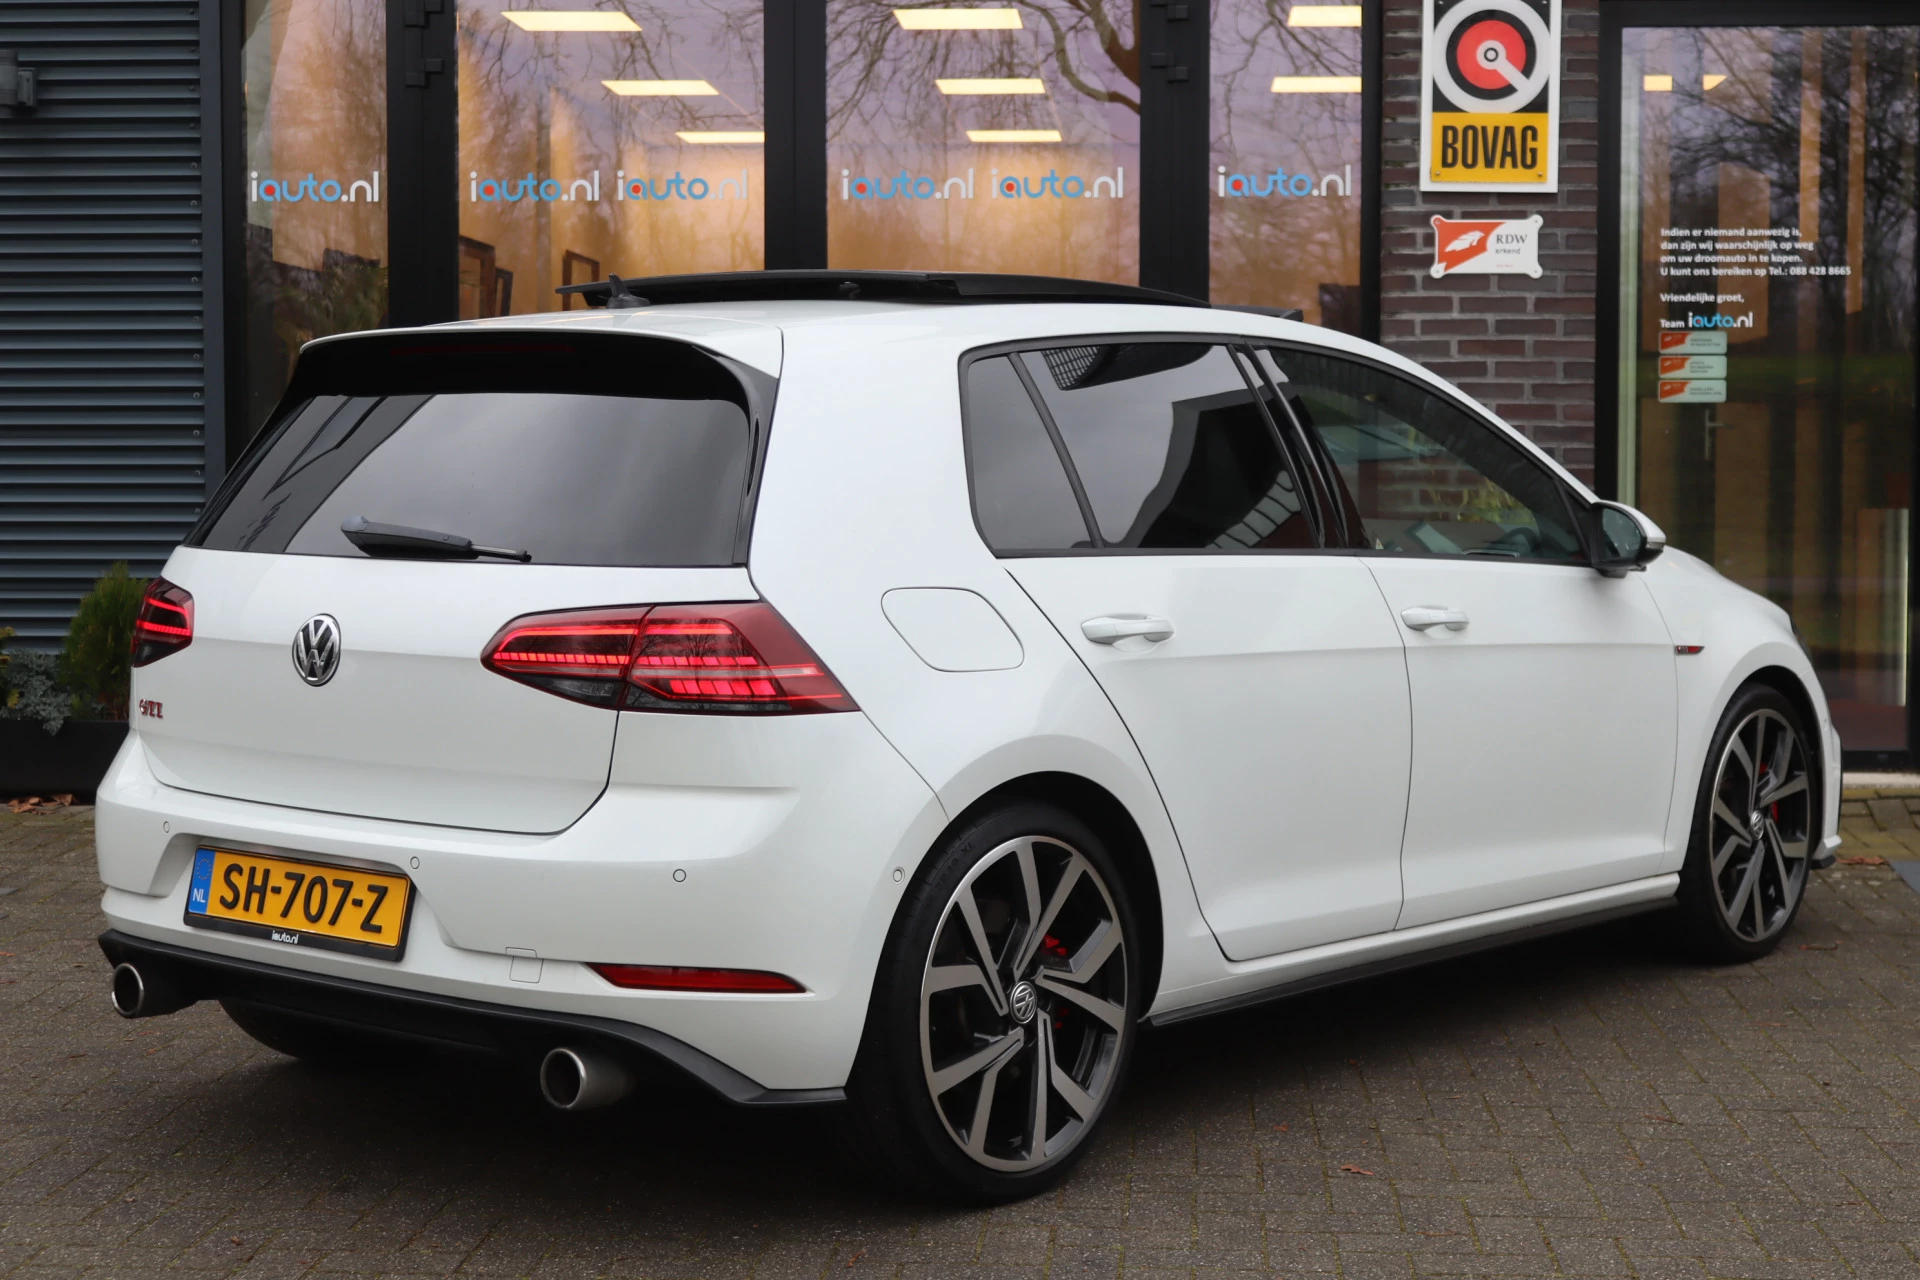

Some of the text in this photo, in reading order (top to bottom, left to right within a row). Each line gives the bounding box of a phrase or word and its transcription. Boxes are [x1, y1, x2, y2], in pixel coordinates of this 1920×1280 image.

[1441, 125, 1538, 170] BOVAG
[250, 170, 379, 202] iauto.nl
[470, 170, 600, 202] iauto.nl
[617, 168, 747, 201] iauto.nl
[841, 168, 974, 200] iauto.nl
[991, 166, 1123, 200] iauto.nl
[1217, 164, 1352, 198] iauto.nl
[1496, 234, 1528, 244] RDW
[1660, 228, 1690, 236] Indien
[1704, 227, 1745, 236] niemand
[1747, 228, 1790, 238] aanwezig
[1792, 227, 1802, 238] is,
[1495, 247, 1521, 255] erkend
[1661, 240, 1814, 251] dan zijn wij waarschijnlijk op weg
[1694, 254, 1746, 262] droomauto
[1748, 254, 1757, 262] in
[1759, 254, 1769, 262] te
[1771, 253, 1802, 264] kopen.
[1660, 267, 1668, 275] U
[1670, 267, 1691, 275] kunt
[1711, 266, 1752, 275] bereiken
[1754, 268, 1767, 277] op
[1769, 266, 1787, 275] Tel.:
[1789, 266, 1807, 275] 088
[1808, 266, 1826, 275] 428
[1660, 293, 1744, 303] Vriendelijke groet,
[1660, 312, 1753, 328] Team iauto.nl
[192, 888, 206, 903] NL
[219, 863, 389, 934] SH-707-Z
